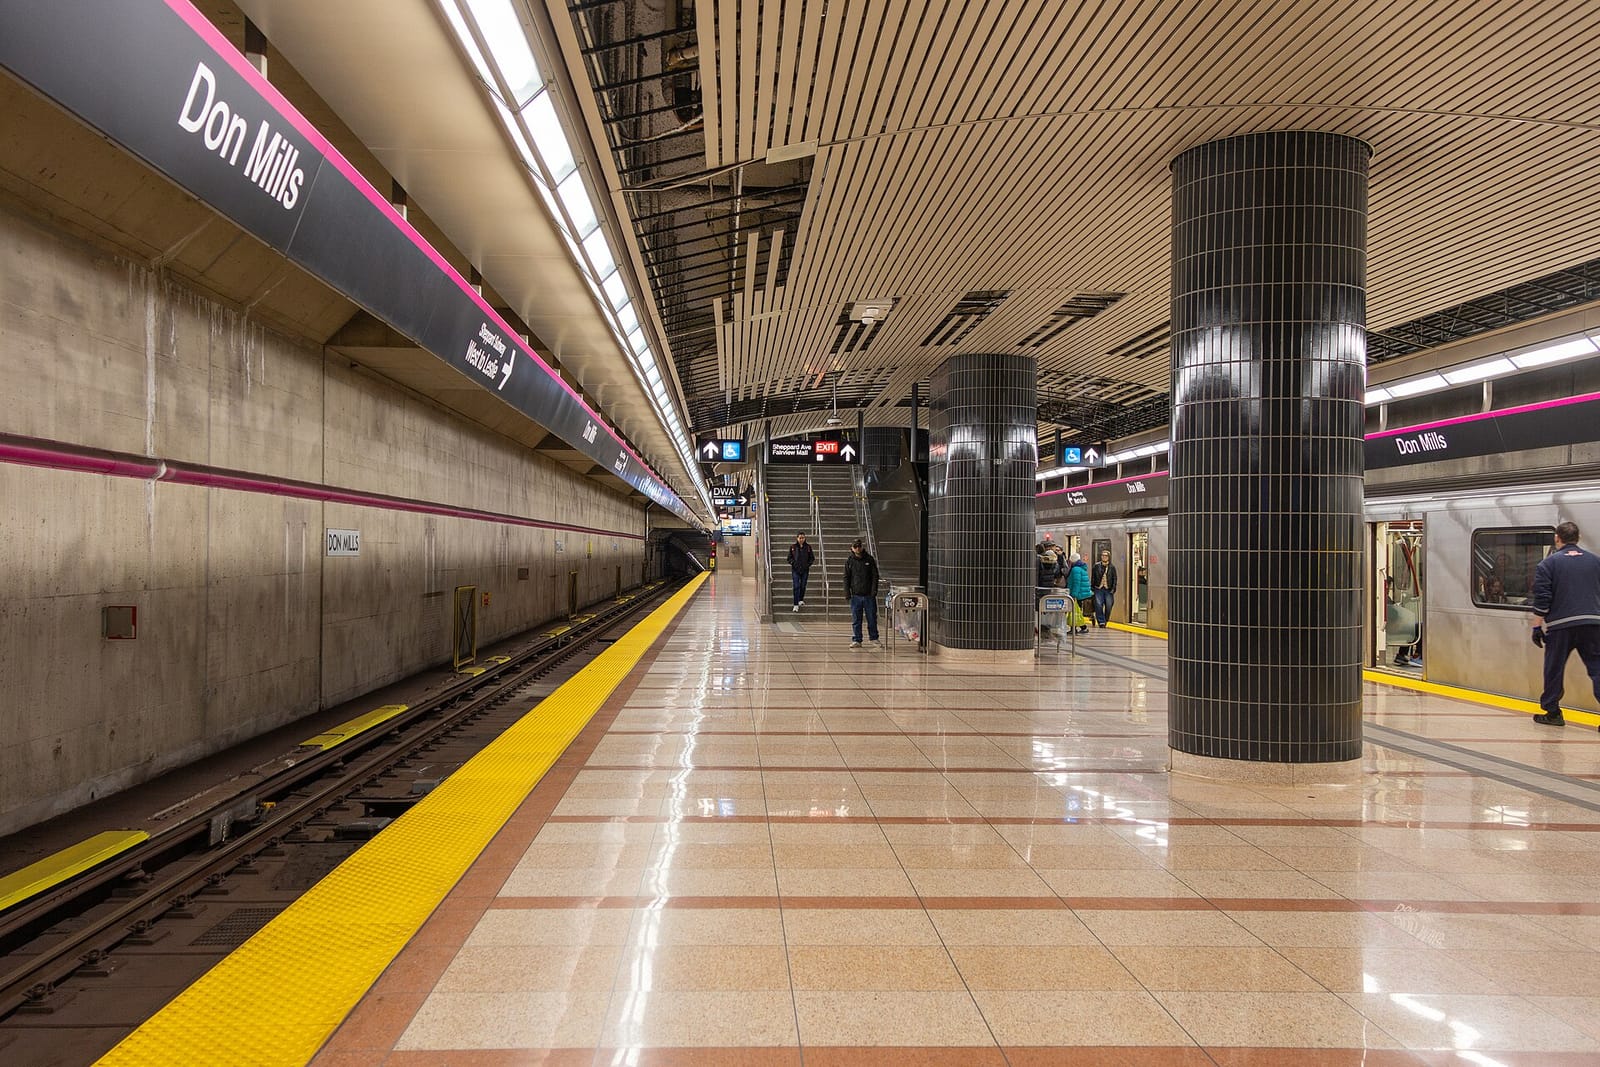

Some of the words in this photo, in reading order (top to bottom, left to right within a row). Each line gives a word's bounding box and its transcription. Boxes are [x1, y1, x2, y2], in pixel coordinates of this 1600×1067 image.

[178, 61, 247, 166] Don
[243, 119, 304, 210] Mills
[465, 339, 482, 367] West
[772, 443, 800, 452] Sheppard
[816, 443, 835, 452] EXIT
[1395, 438, 1420, 454] Don
[1418, 431, 1447, 451] Mills
[713, 487, 735, 496] DWA
[329, 534, 341, 551] DON
[342, 535, 358, 551] MILLS
